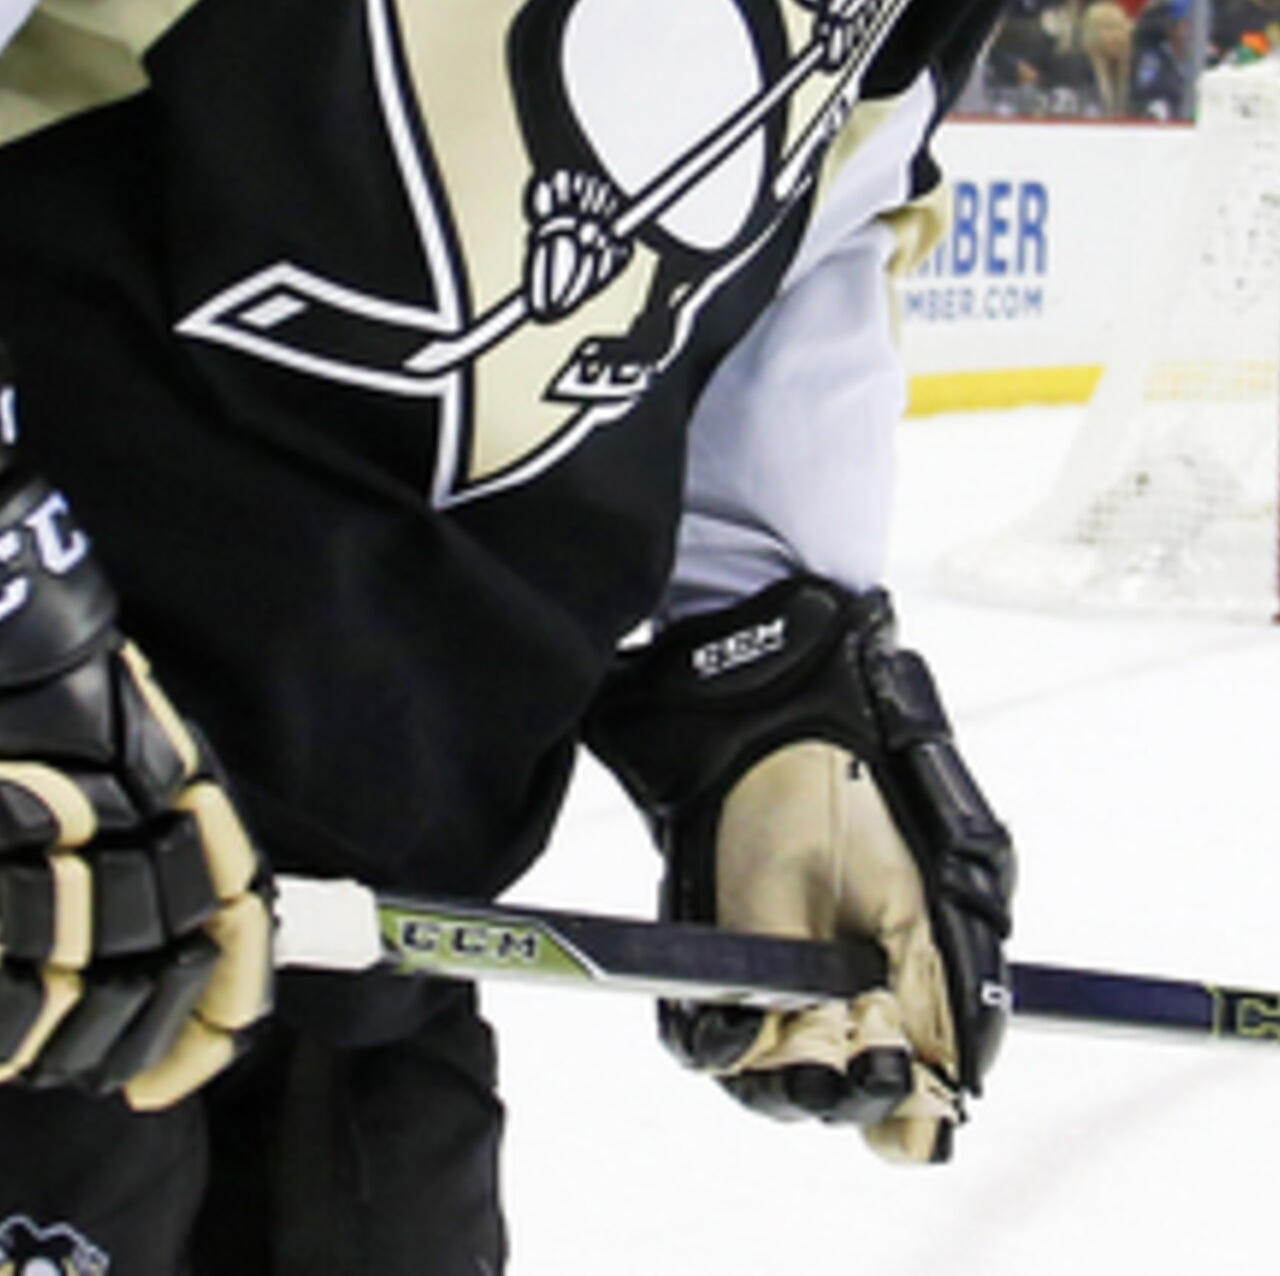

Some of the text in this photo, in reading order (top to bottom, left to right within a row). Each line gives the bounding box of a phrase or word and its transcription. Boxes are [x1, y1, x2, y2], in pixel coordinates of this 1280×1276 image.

[918, 181, 1048, 275] BER
[692, 617, 785, 677] CCM
[402, 921, 538, 960] CCM
